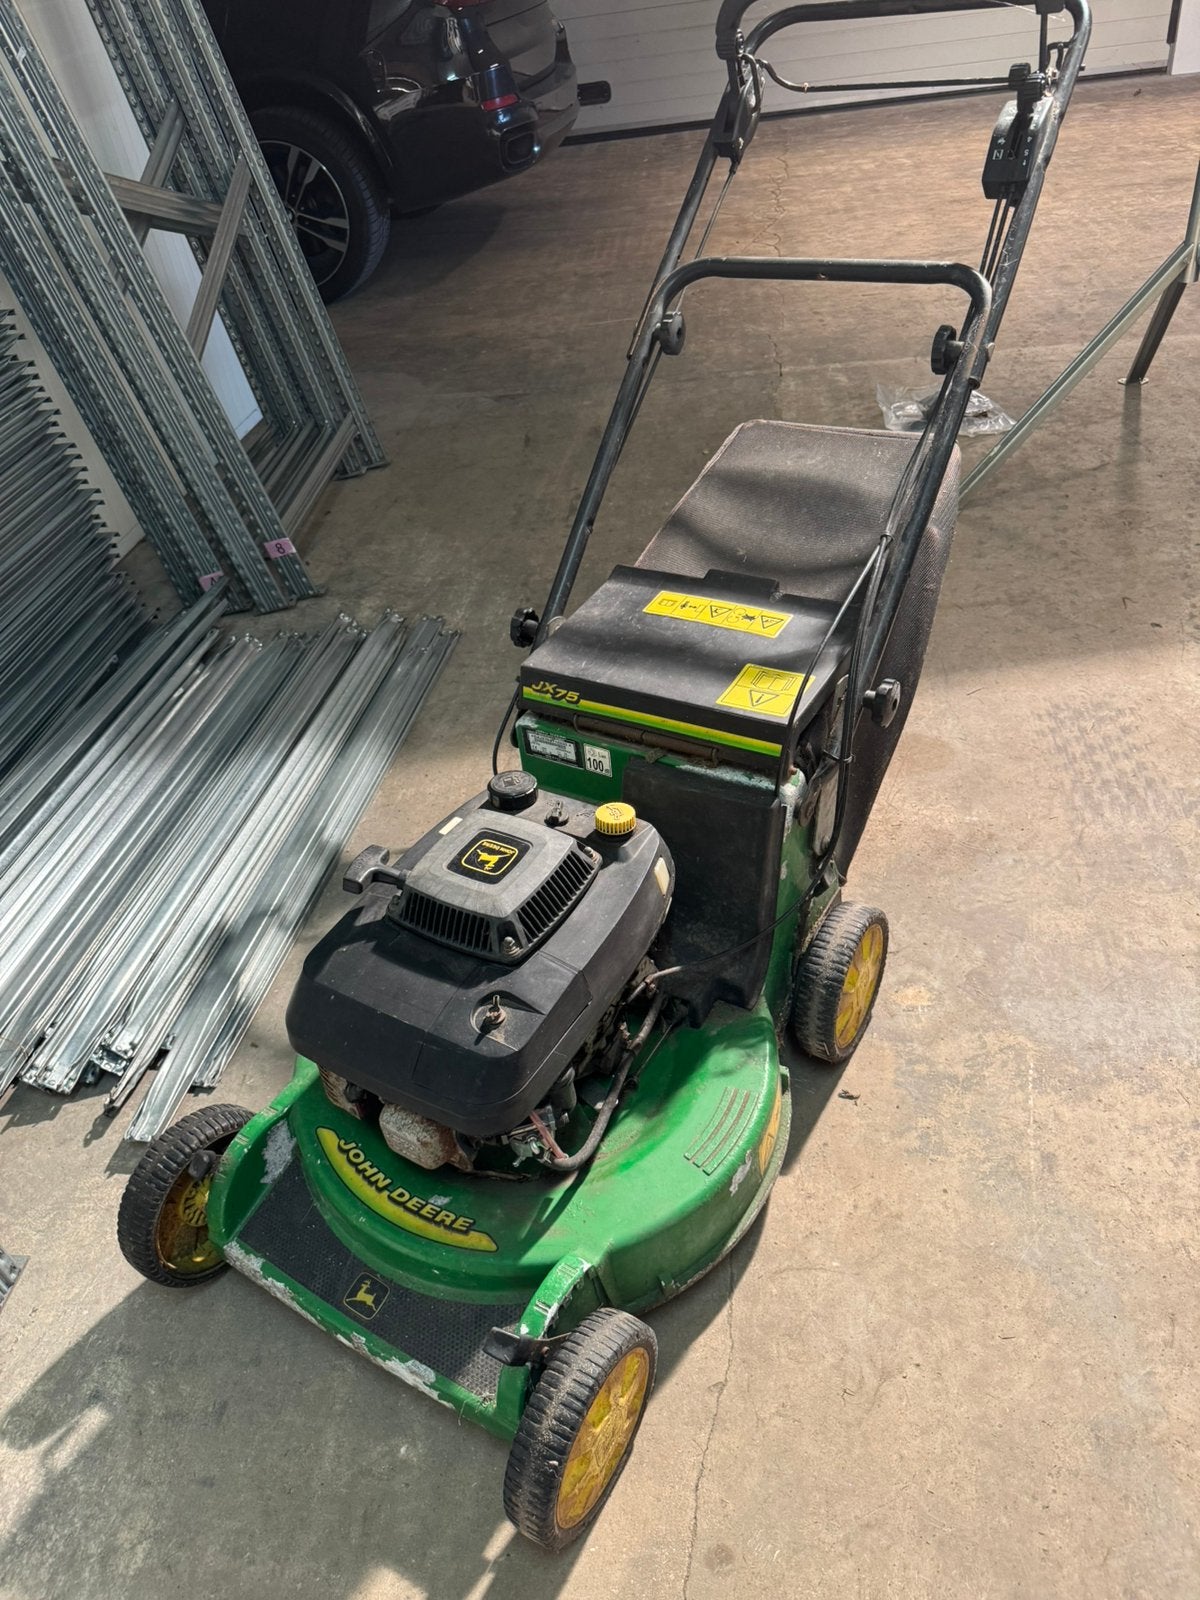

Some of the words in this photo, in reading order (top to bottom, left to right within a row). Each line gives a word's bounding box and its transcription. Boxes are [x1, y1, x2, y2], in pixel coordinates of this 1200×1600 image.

[275, 542, 286, 554] 8
[531, 681, 580, 702] JX75
[587, 757, 604, 772] 100
[338, 1138, 393, 1189] JOHN
[389, 1187, 475, 1231] DEERE
